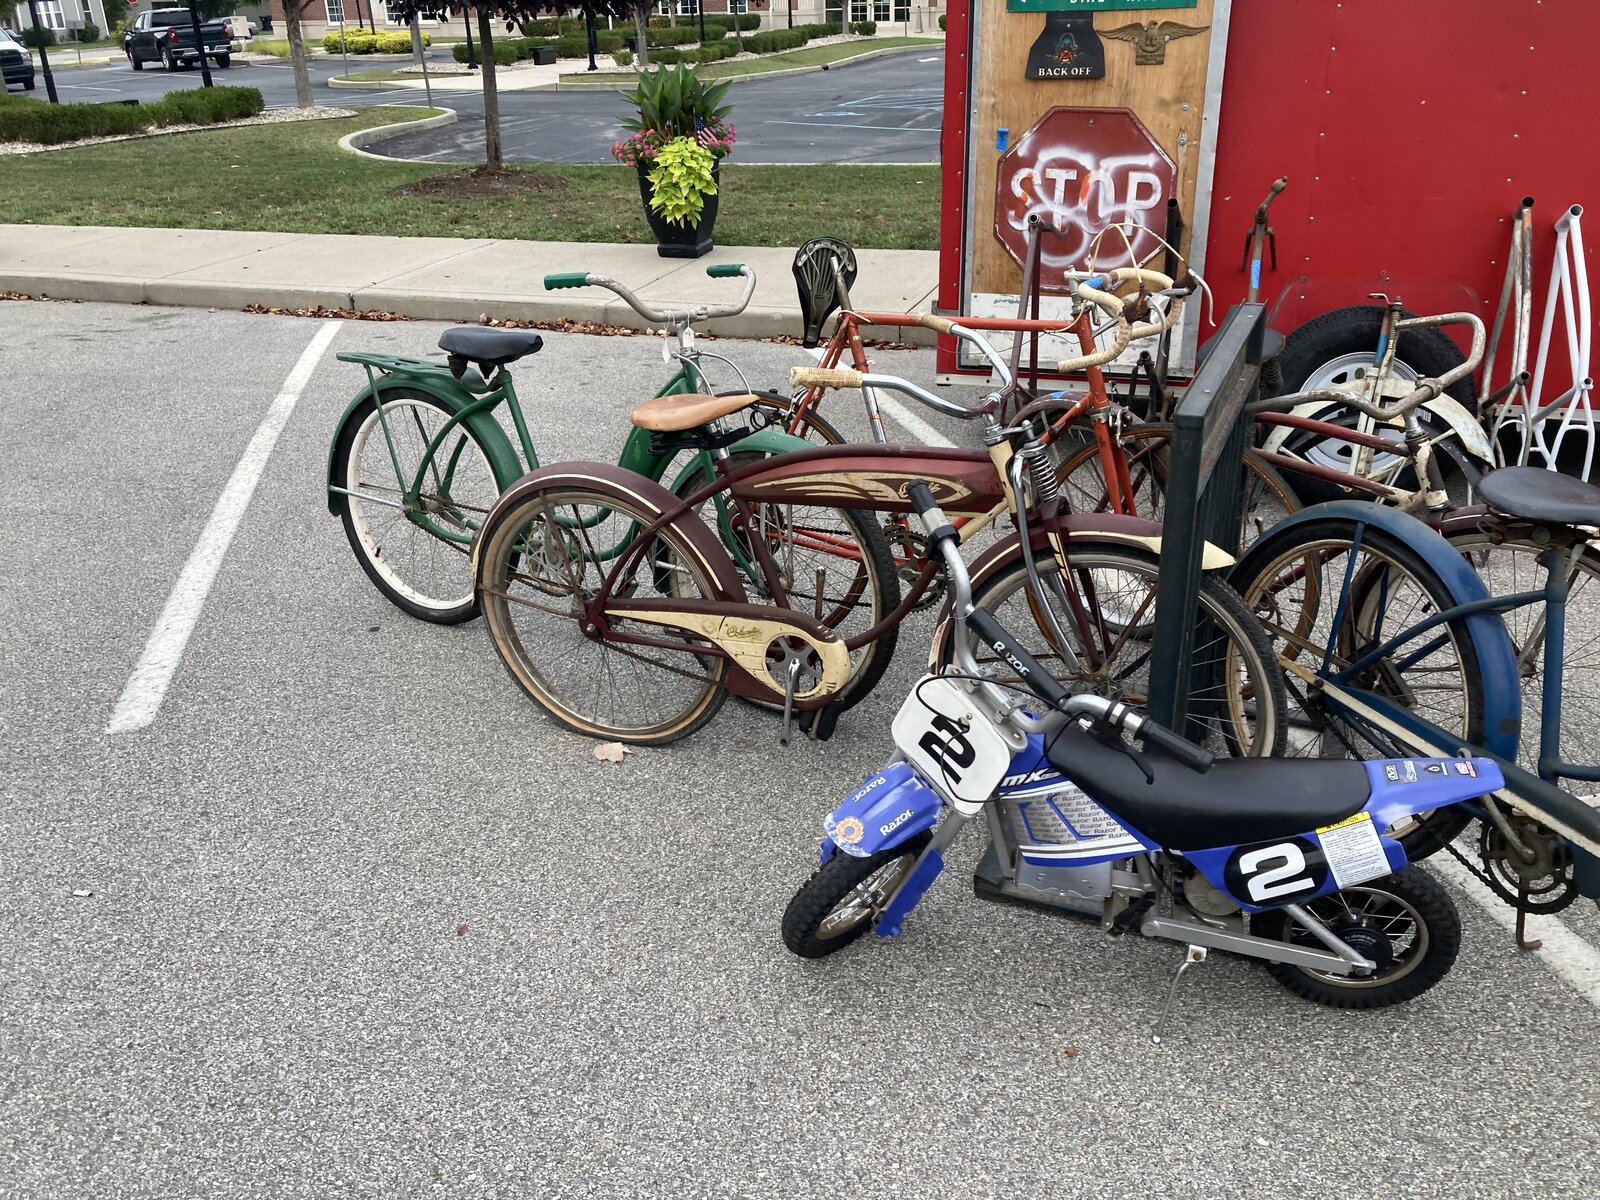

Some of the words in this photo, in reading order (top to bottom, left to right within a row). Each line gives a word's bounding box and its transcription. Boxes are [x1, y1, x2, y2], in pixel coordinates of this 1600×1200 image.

[1038, 66, 1068, 77] BACK
[1071, 66, 1093, 76] OFF
[1008, 167, 1162, 237] STOP
[993, 641, 1030, 675] Rzor
[918, 715, 976, 785] 2
[852, 776, 887, 803] Razor
[880, 809, 914, 836] Razor
[1239, 843, 1315, 902] 2
